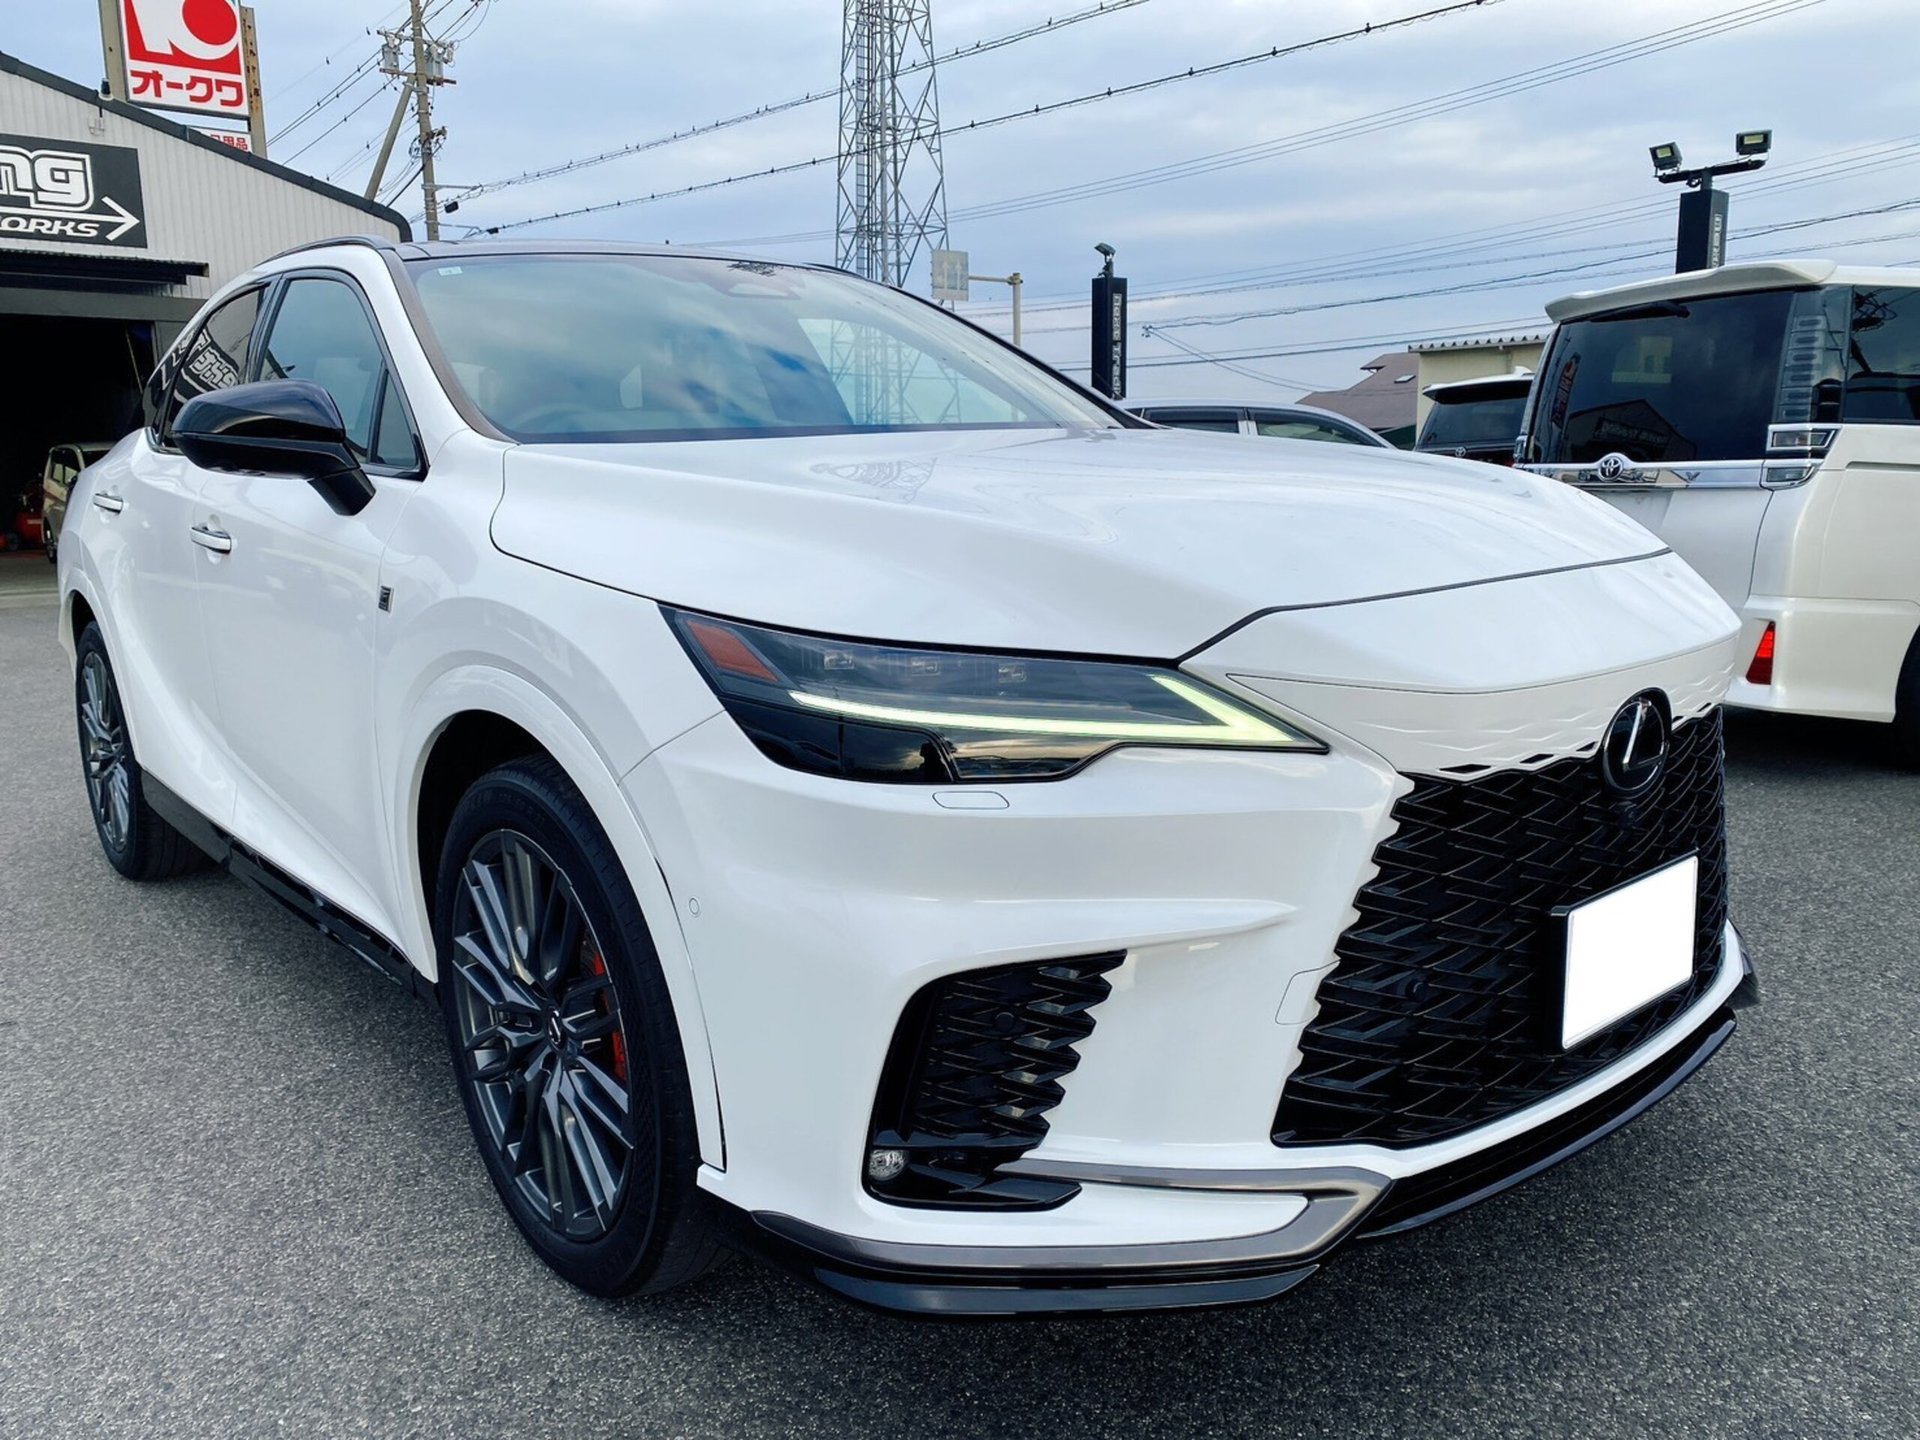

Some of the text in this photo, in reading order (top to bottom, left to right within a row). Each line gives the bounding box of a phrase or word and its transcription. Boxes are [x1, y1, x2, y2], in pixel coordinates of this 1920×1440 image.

[130, 70, 243, 107] オークワ
[0, 215, 100, 237] ORKS
